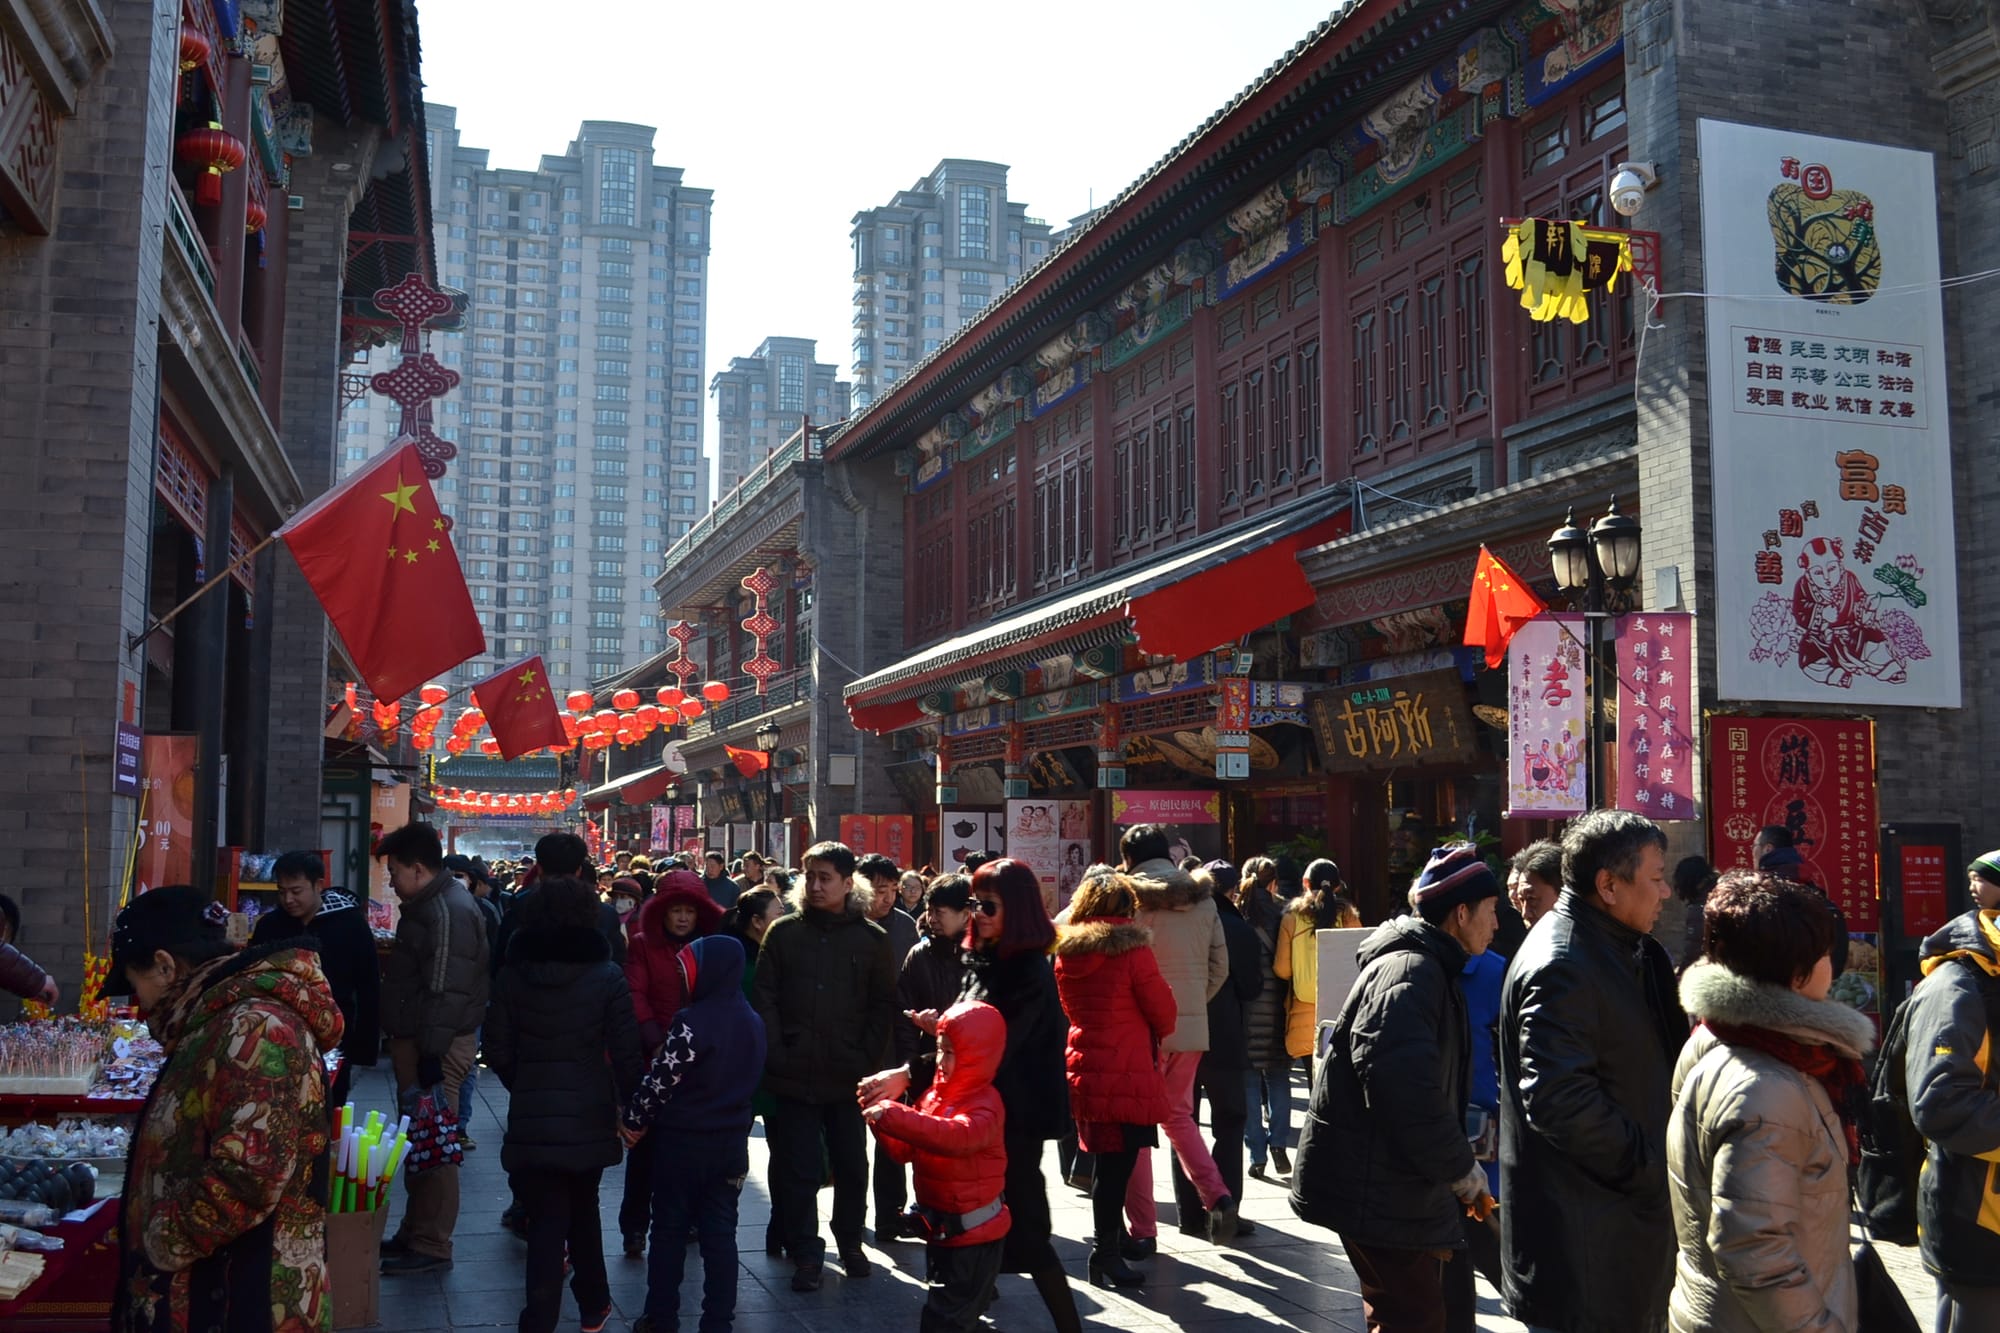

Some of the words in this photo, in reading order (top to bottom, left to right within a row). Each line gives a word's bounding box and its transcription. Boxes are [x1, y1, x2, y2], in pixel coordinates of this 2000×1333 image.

[1744, 334, 1783, 355] 富强
[1790, 340, 1828, 360] 民主
[1834, 345, 1870, 365] 文明
[1877, 349, 1913, 368] 和谐
[1746, 360, 1784, 381] 自由
[1790, 366, 1829, 386] 平等
[1834, 371, 1872, 389] 公正
[1878, 374, 1914, 393] 法治
[1746, 387, 1785, 407] 爱国
[1791, 391, 1830, 411] 敬业
[1836, 395, 1873, 415] 诚信
[1879, 399, 1916, 418] 友善
[1835, 449, 1907, 515] 富贵
[1852, 506, 1889, 565] 吉祥
[1540, 657, 1572, 707] 孝
[1632, 617, 1650, 803] 文明创建重在行动
[1736, 754, 1747, 809] 中华老字号
